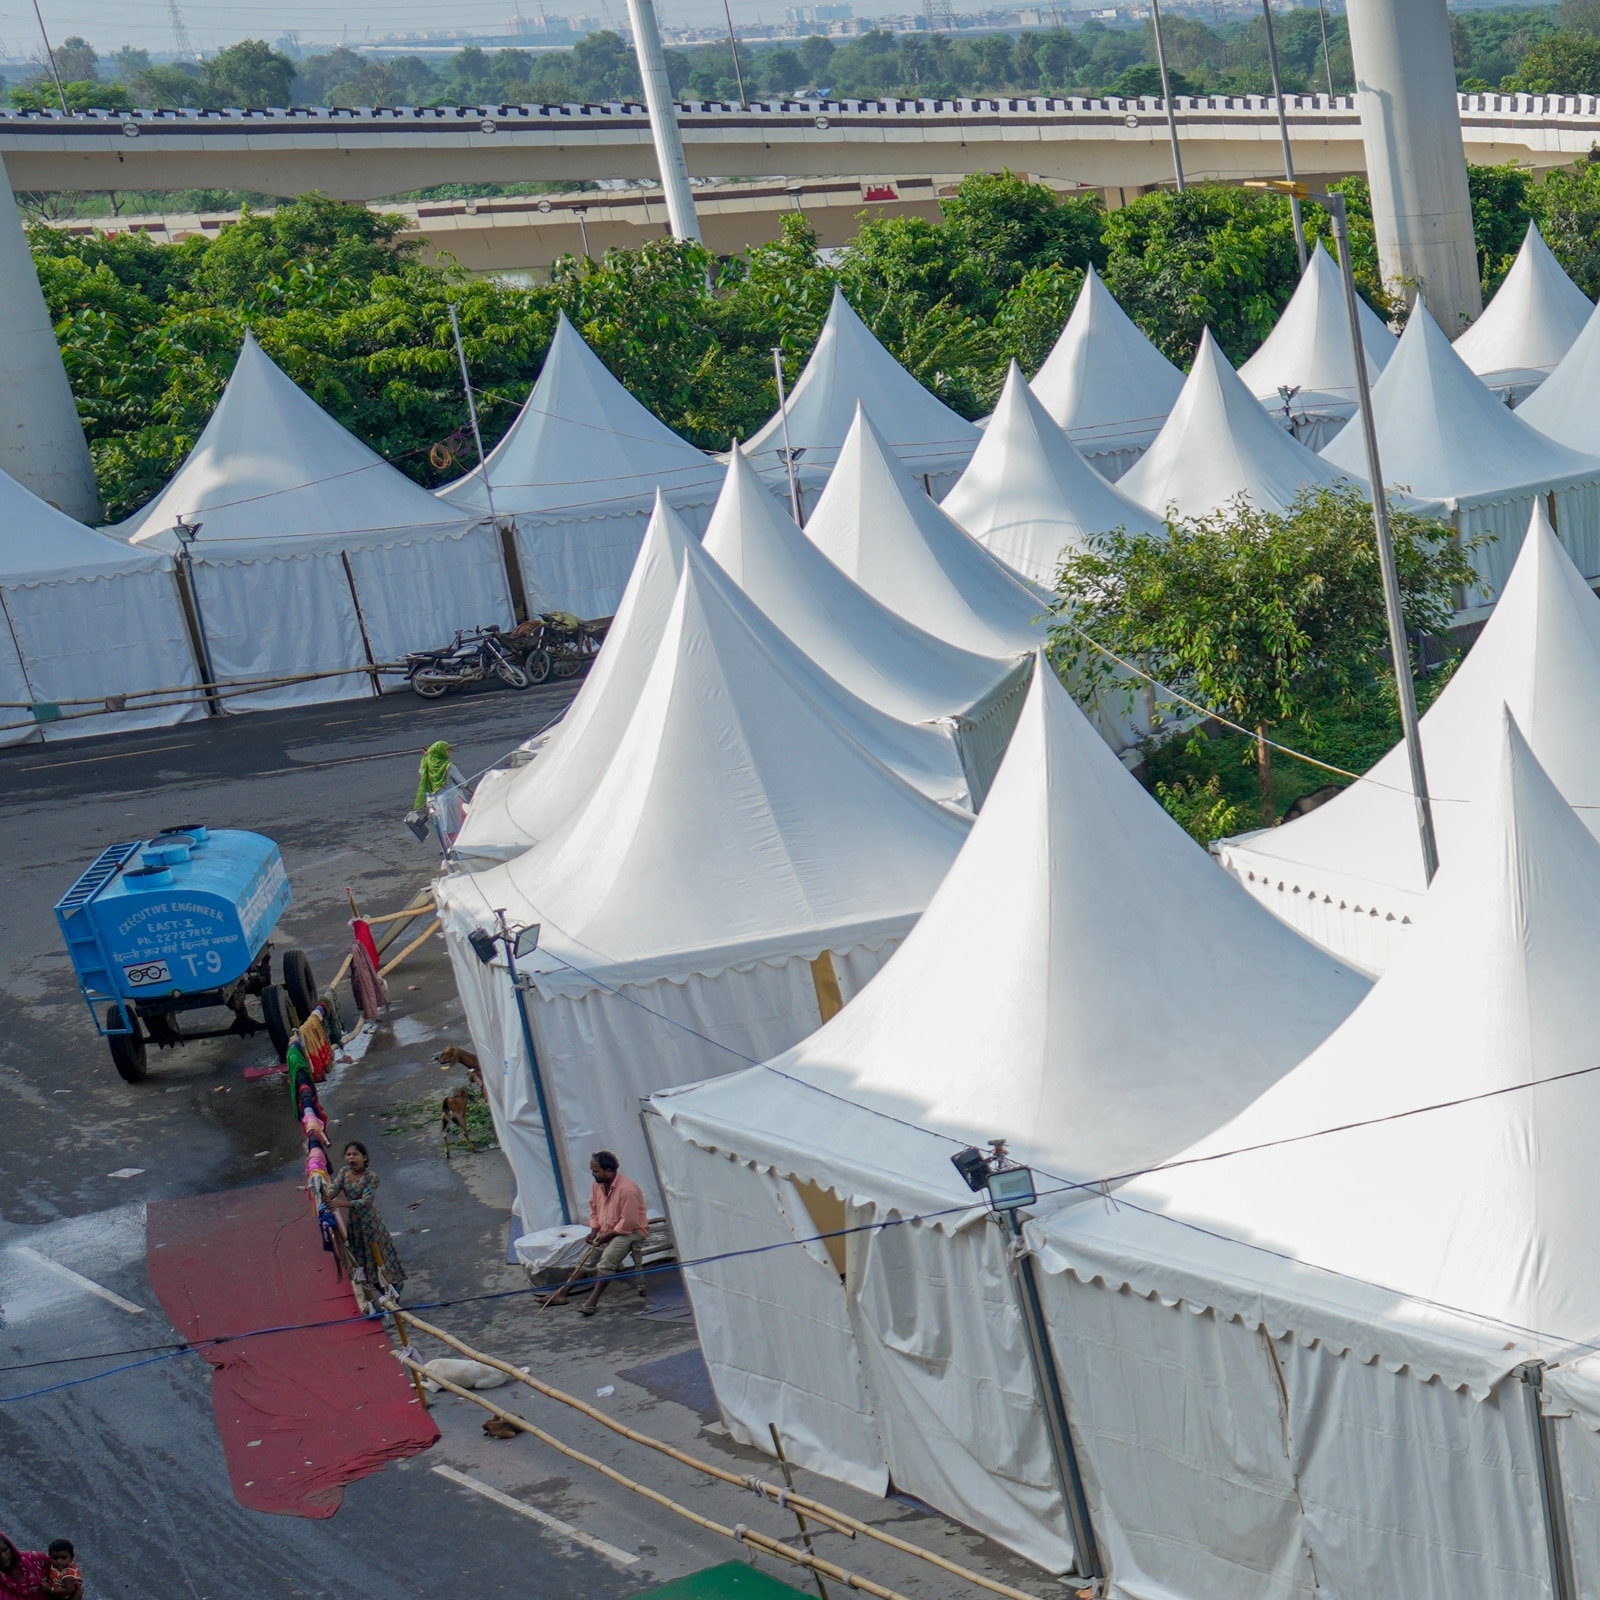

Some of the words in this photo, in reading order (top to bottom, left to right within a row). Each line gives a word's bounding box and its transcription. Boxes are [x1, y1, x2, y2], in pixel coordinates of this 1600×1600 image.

[118, 903, 170, 936] EXECUTIVE
[171, 902, 225, 922] ENGINEER
[112, 949, 140, 962] दिल्ली
[180, 938, 210, 950] दिल्ली
[181, 951, 222, 977] T-9
